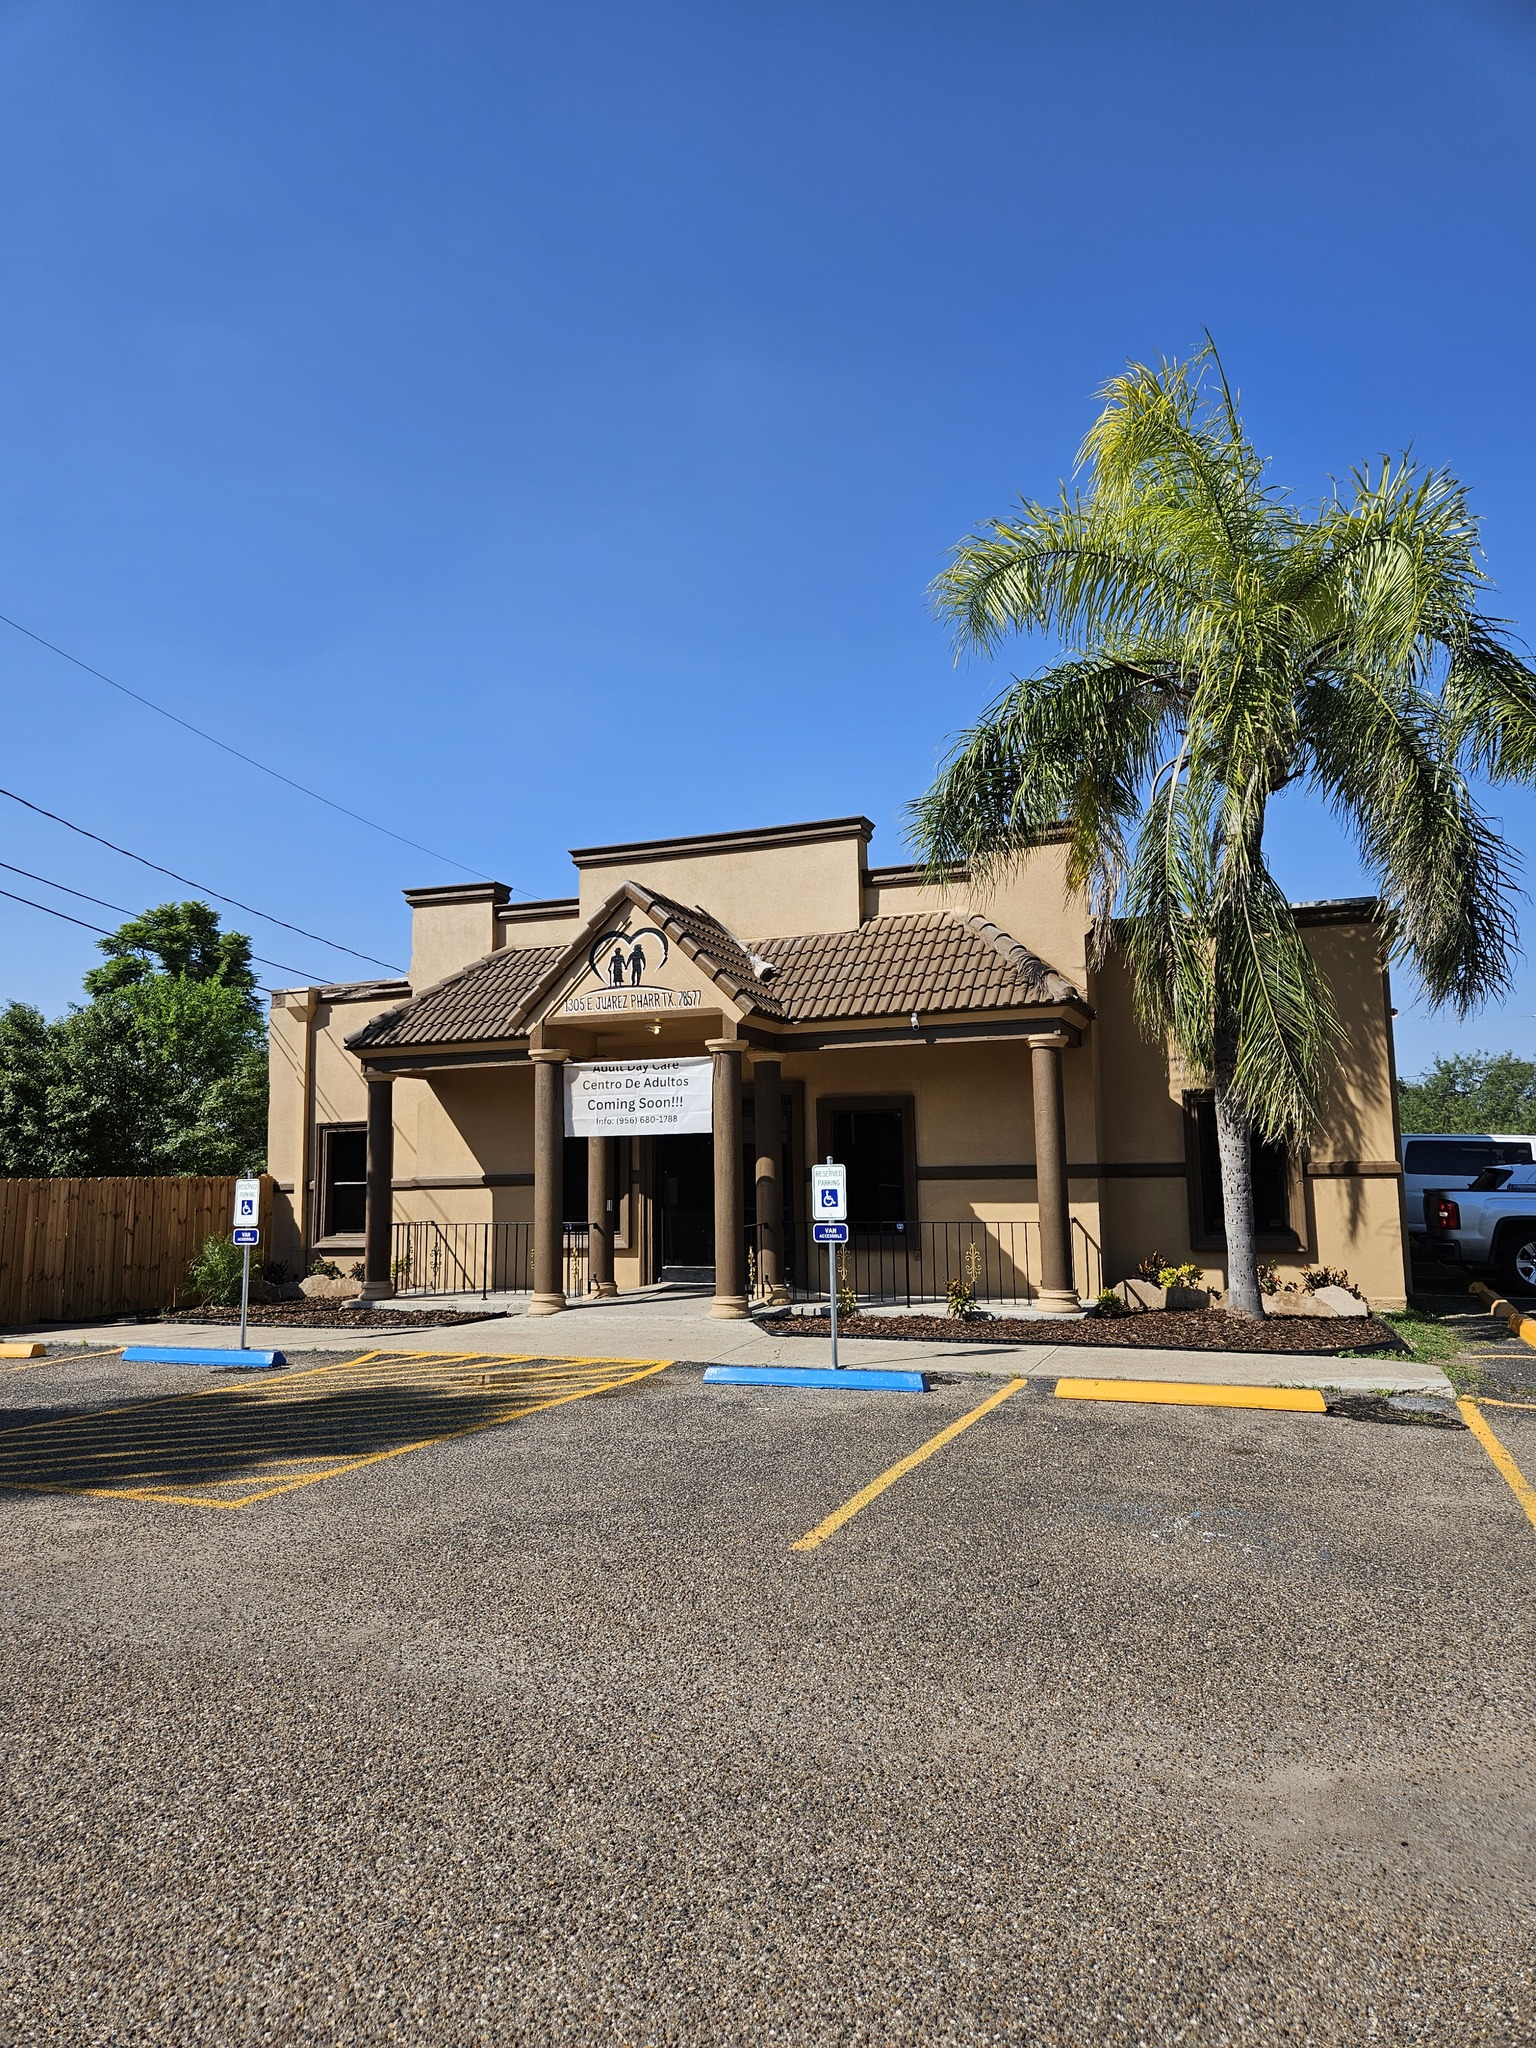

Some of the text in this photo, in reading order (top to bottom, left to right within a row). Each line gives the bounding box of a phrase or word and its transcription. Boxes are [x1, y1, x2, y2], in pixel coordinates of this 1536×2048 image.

[565, 998, 585, 1012] 1305
[596, 995, 628, 1010] JUAREZ
[630, 993, 660, 1008] PHARR
[678, 990, 702, 1006] 78577
[583, 1077, 689, 1091] Centro De Adultos
[587, 1096, 683, 1112] Coming Soon!!!
[596, 1115, 678, 1125] Info: (956) 680-1788
[815, 1170, 842, 1178] RESERVED
